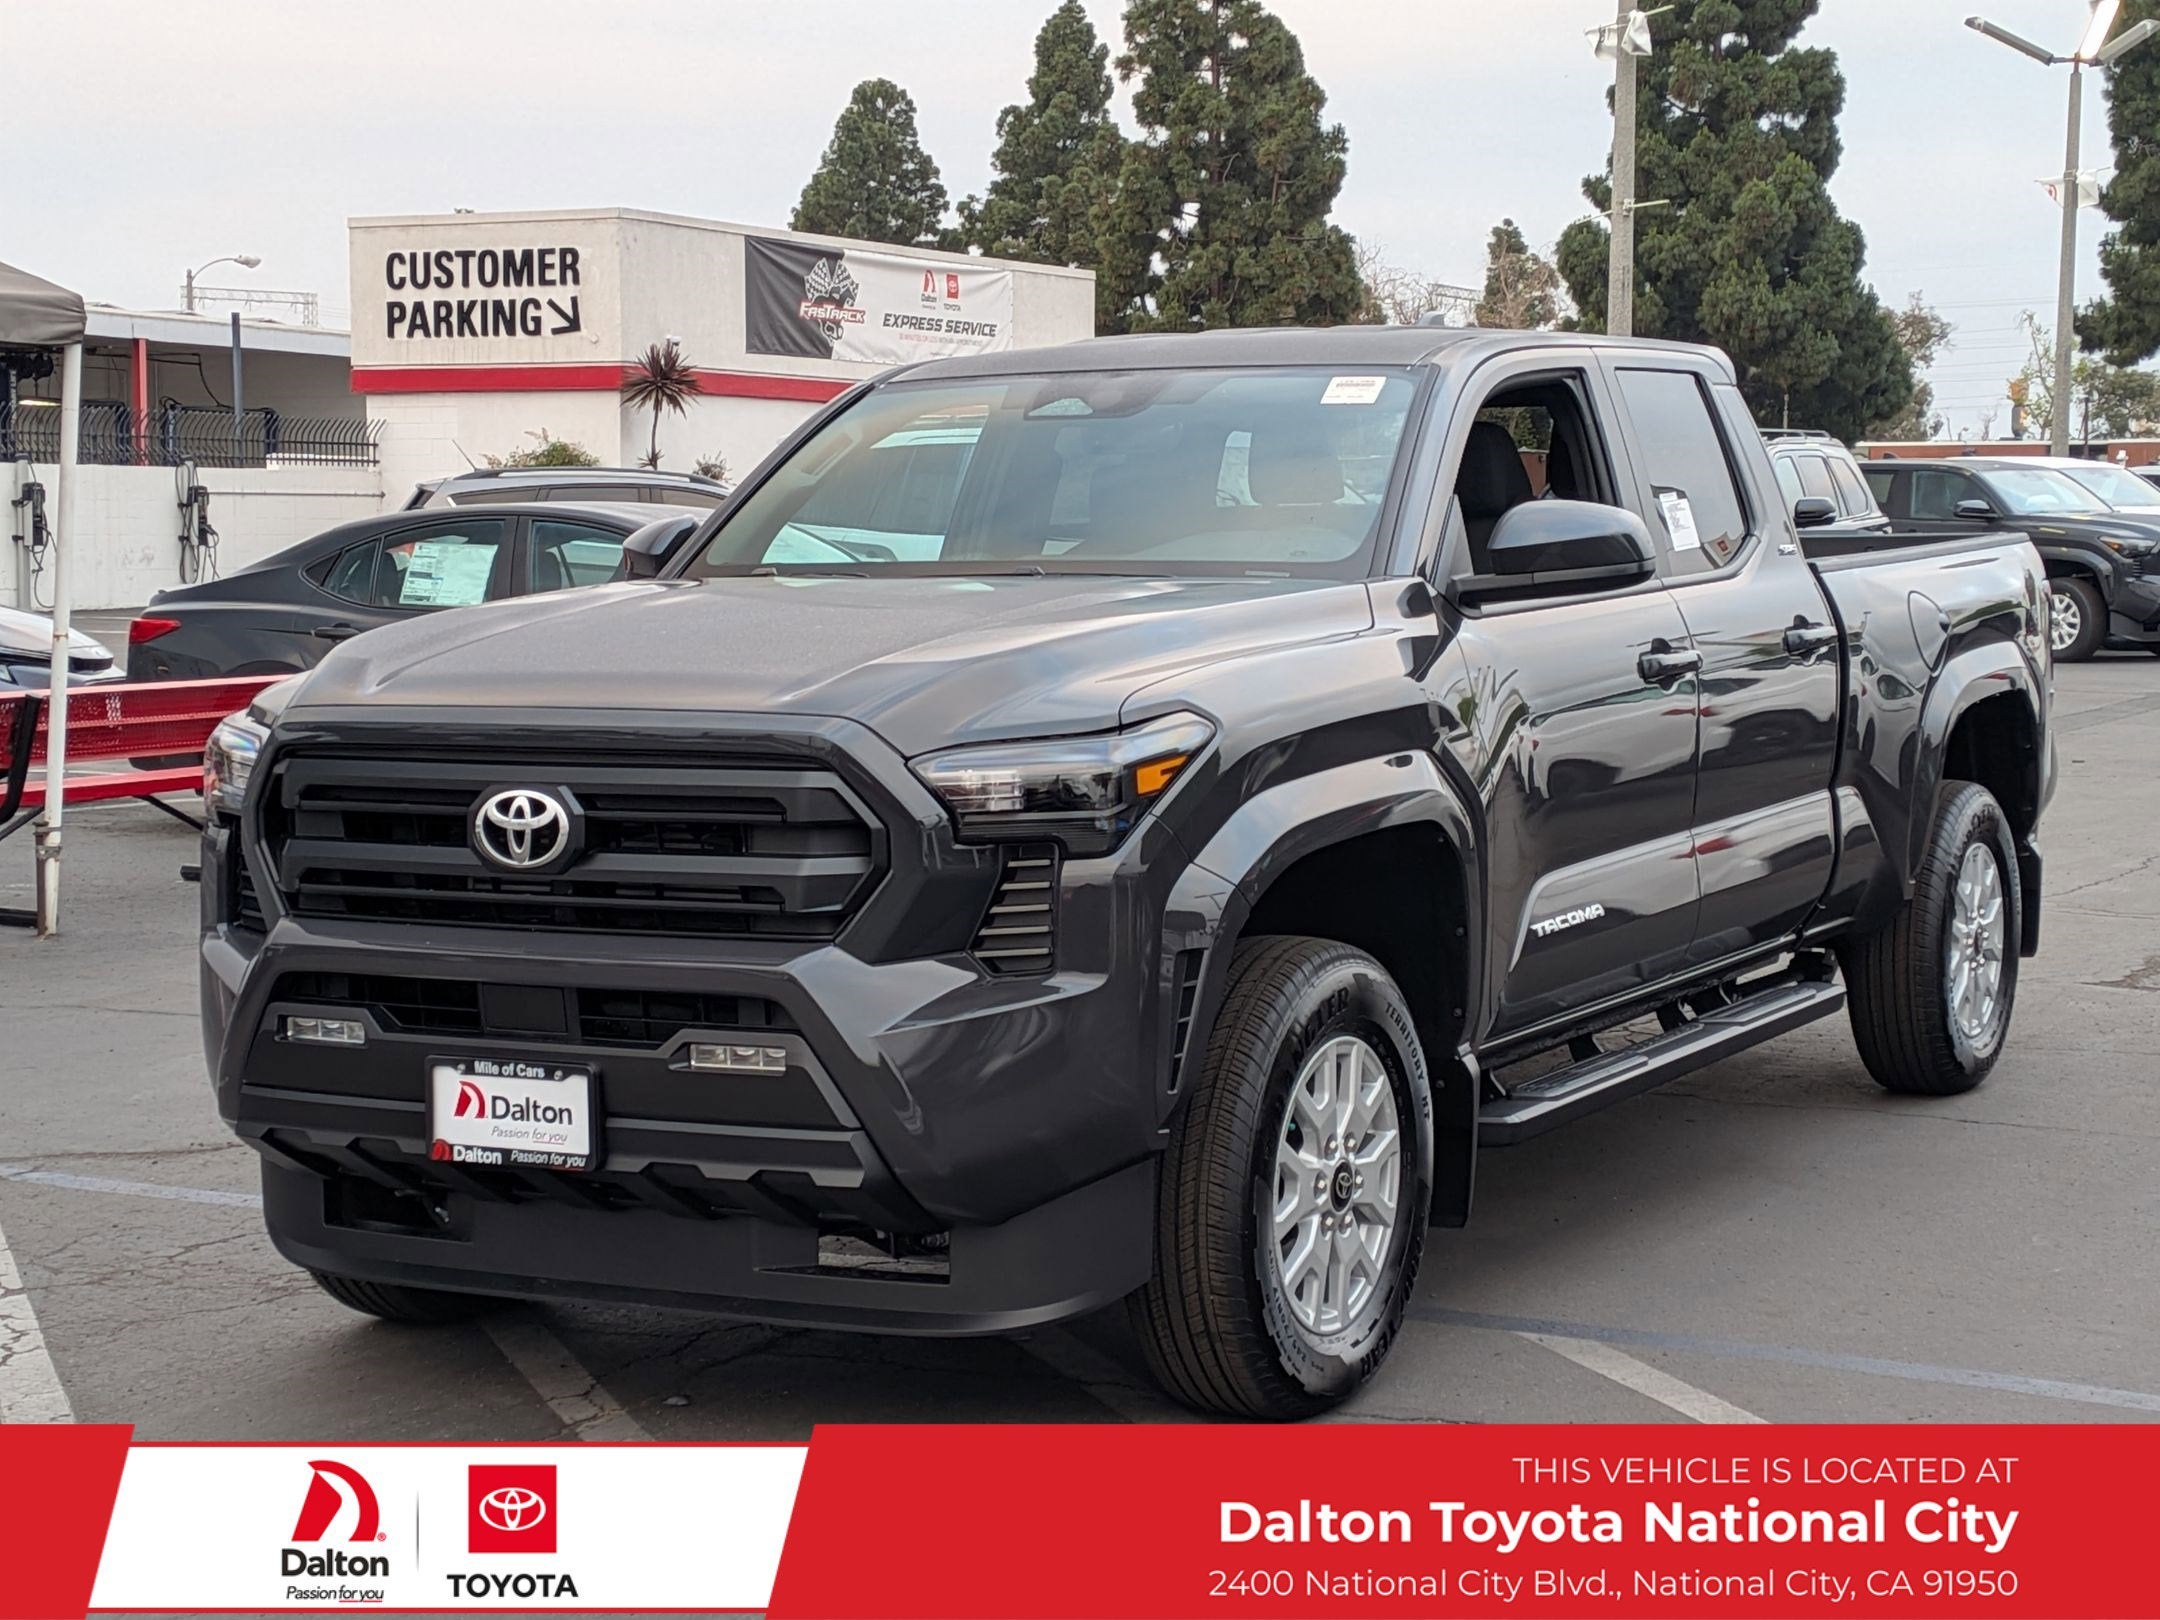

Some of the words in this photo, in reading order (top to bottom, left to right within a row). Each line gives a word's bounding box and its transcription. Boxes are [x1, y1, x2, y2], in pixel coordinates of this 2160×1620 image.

[386, 247, 580, 291] CUSTOMER
[386, 297, 542, 339] PARKING
[883, 313, 943, 333] EXPRESS
[944, 319, 998, 338] SERVICE
[1529, 903, 1606, 938] TACOMA
[474, 1061, 499, 1075] Mile
[502, 1062, 515, 1076] of
[516, 1063, 545, 1078] Cars
[491, 1095, 574, 1126] Dalton
[491, 1126, 530, 1140] Passion
[532, 1127, 549, 1141] for
[549, 1132, 568, 1144] you
[453, 1145, 503, 1165] Dalton
[510, 1149, 548, 1165] Passion
[548, 1153, 565, 1166] for
[565, 1155, 586, 1169] you
